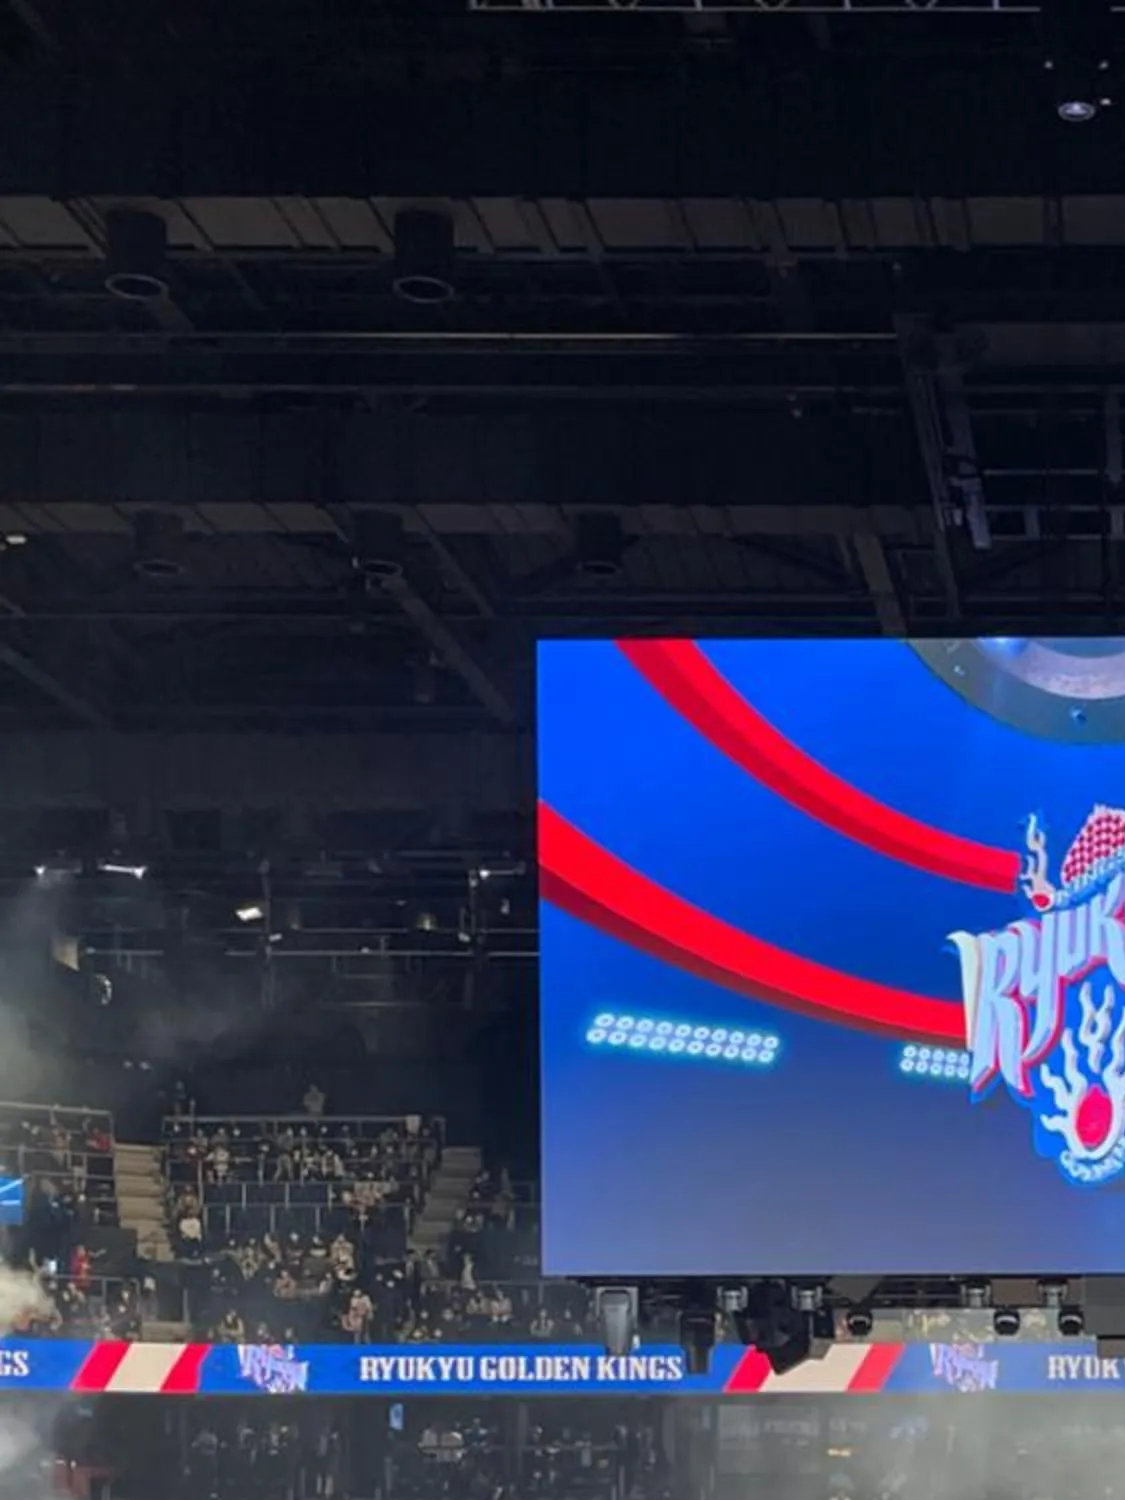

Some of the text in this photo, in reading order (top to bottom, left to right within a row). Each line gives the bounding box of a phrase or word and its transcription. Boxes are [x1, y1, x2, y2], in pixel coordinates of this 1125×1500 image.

[360, 1355, 683, 1381] RYUKYU GOLDEN KINGS
